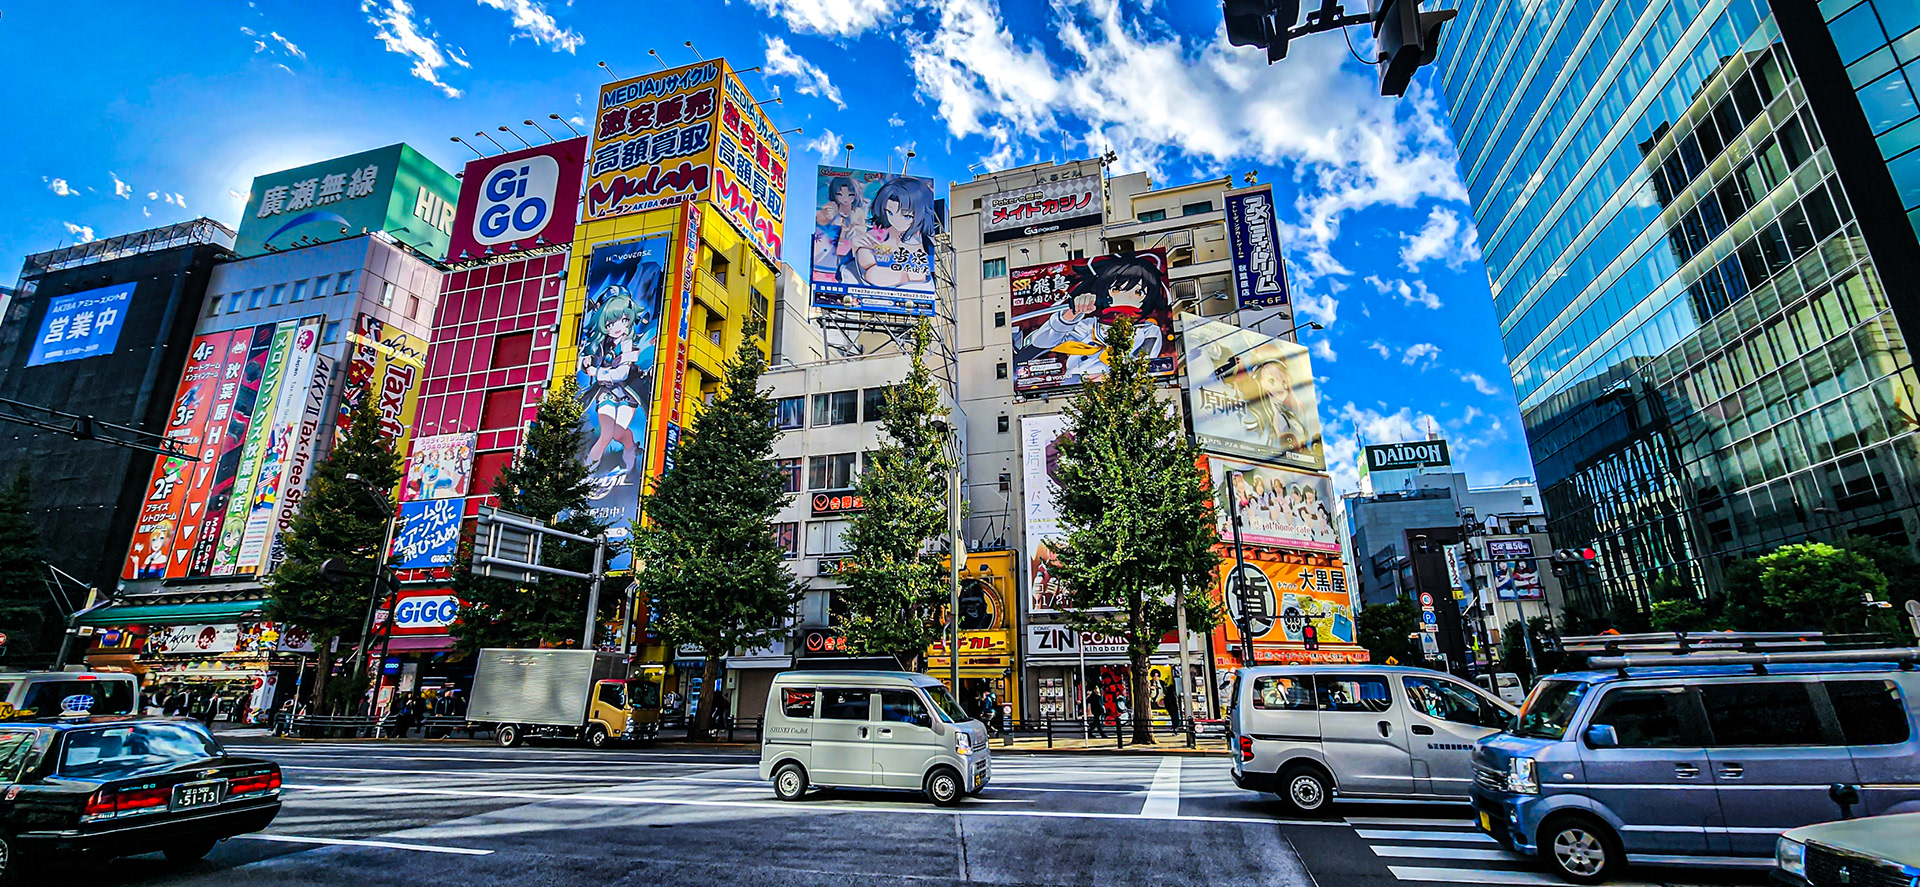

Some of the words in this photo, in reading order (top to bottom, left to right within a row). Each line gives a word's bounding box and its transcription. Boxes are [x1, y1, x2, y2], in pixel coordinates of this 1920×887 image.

[602, 63, 718, 109] MEDIAリサイクル
[598, 87, 716, 140] 激安販売
[724, 74, 787, 161] MEDIAリサイクル
[591, 121, 711, 177] 高額買取
[722, 97, 785, 192] 激安販売
[256, 164, 379, 219] 廣瀬無線
[486, 165, 530, 202] Gi
[588, 162, 710, 217] Mulan
[719, 132, 783, 224] 高額買取
[479, 196, 547, 238] GO
[716, 167, 782, 261] Mulan
[992, 192, 1092, 225] メイドカジノ
[43, 307, 118, 344] 営業中
[192, 341, 215, 361] 4F
[172, 405, 195, 426] 3F
[149, 478, 174, 501] 2F
[278, 487, 301, 530] Shop
[1299, 568, 1347, 593] 大黒屋
[824, 636, 848, 650] 吉野
[1034, 629, 1074, 651] ZIN
[184, 792, 215, 805] 51-13
